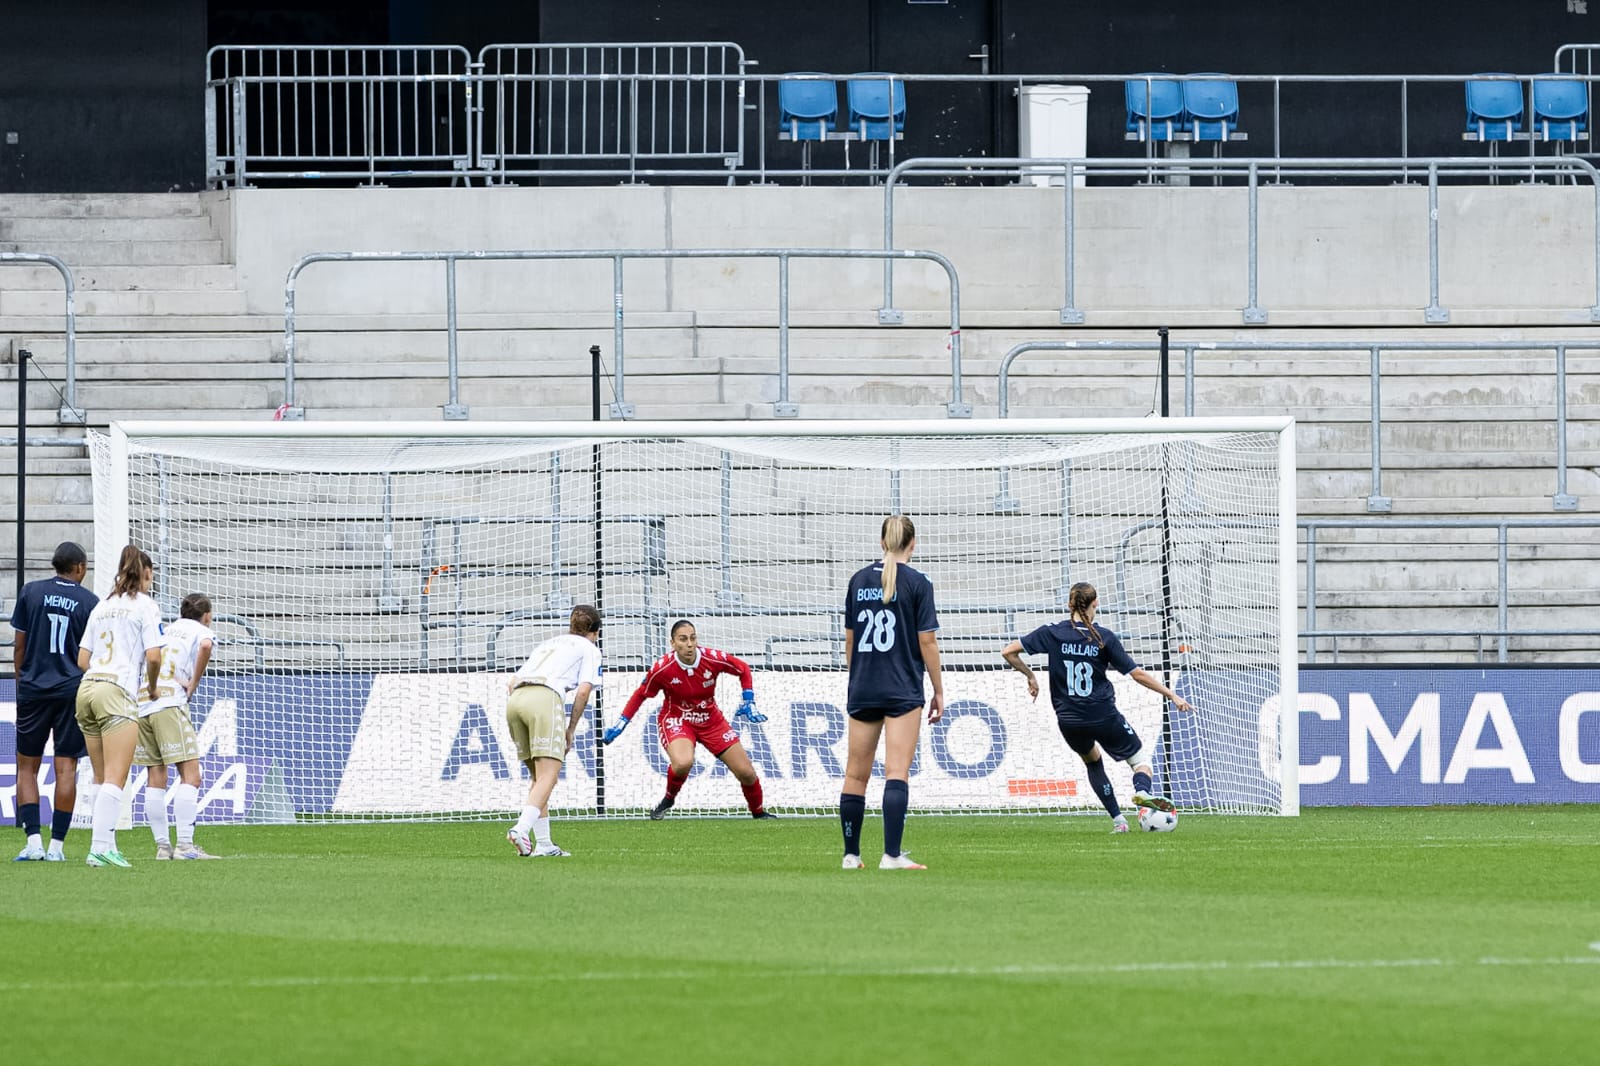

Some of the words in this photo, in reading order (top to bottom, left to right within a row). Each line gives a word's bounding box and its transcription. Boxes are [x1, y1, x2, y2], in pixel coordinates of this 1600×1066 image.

[43, 595, 79, 612] MENDY
[857, 588, 897, 602] BOISA
[47, 613, 69, 655] 11
[98, 630, 115, 666] 3
[857, 609, 896, 653] 28
[1061, 643, 1099, 657] GALLAIS
[1063, 660, 1094, 697] 18
[440, 704, 603, 780] AR
[642, 700, 1008, 779] CARO
[1258, 692, 1536, 784] CMA
